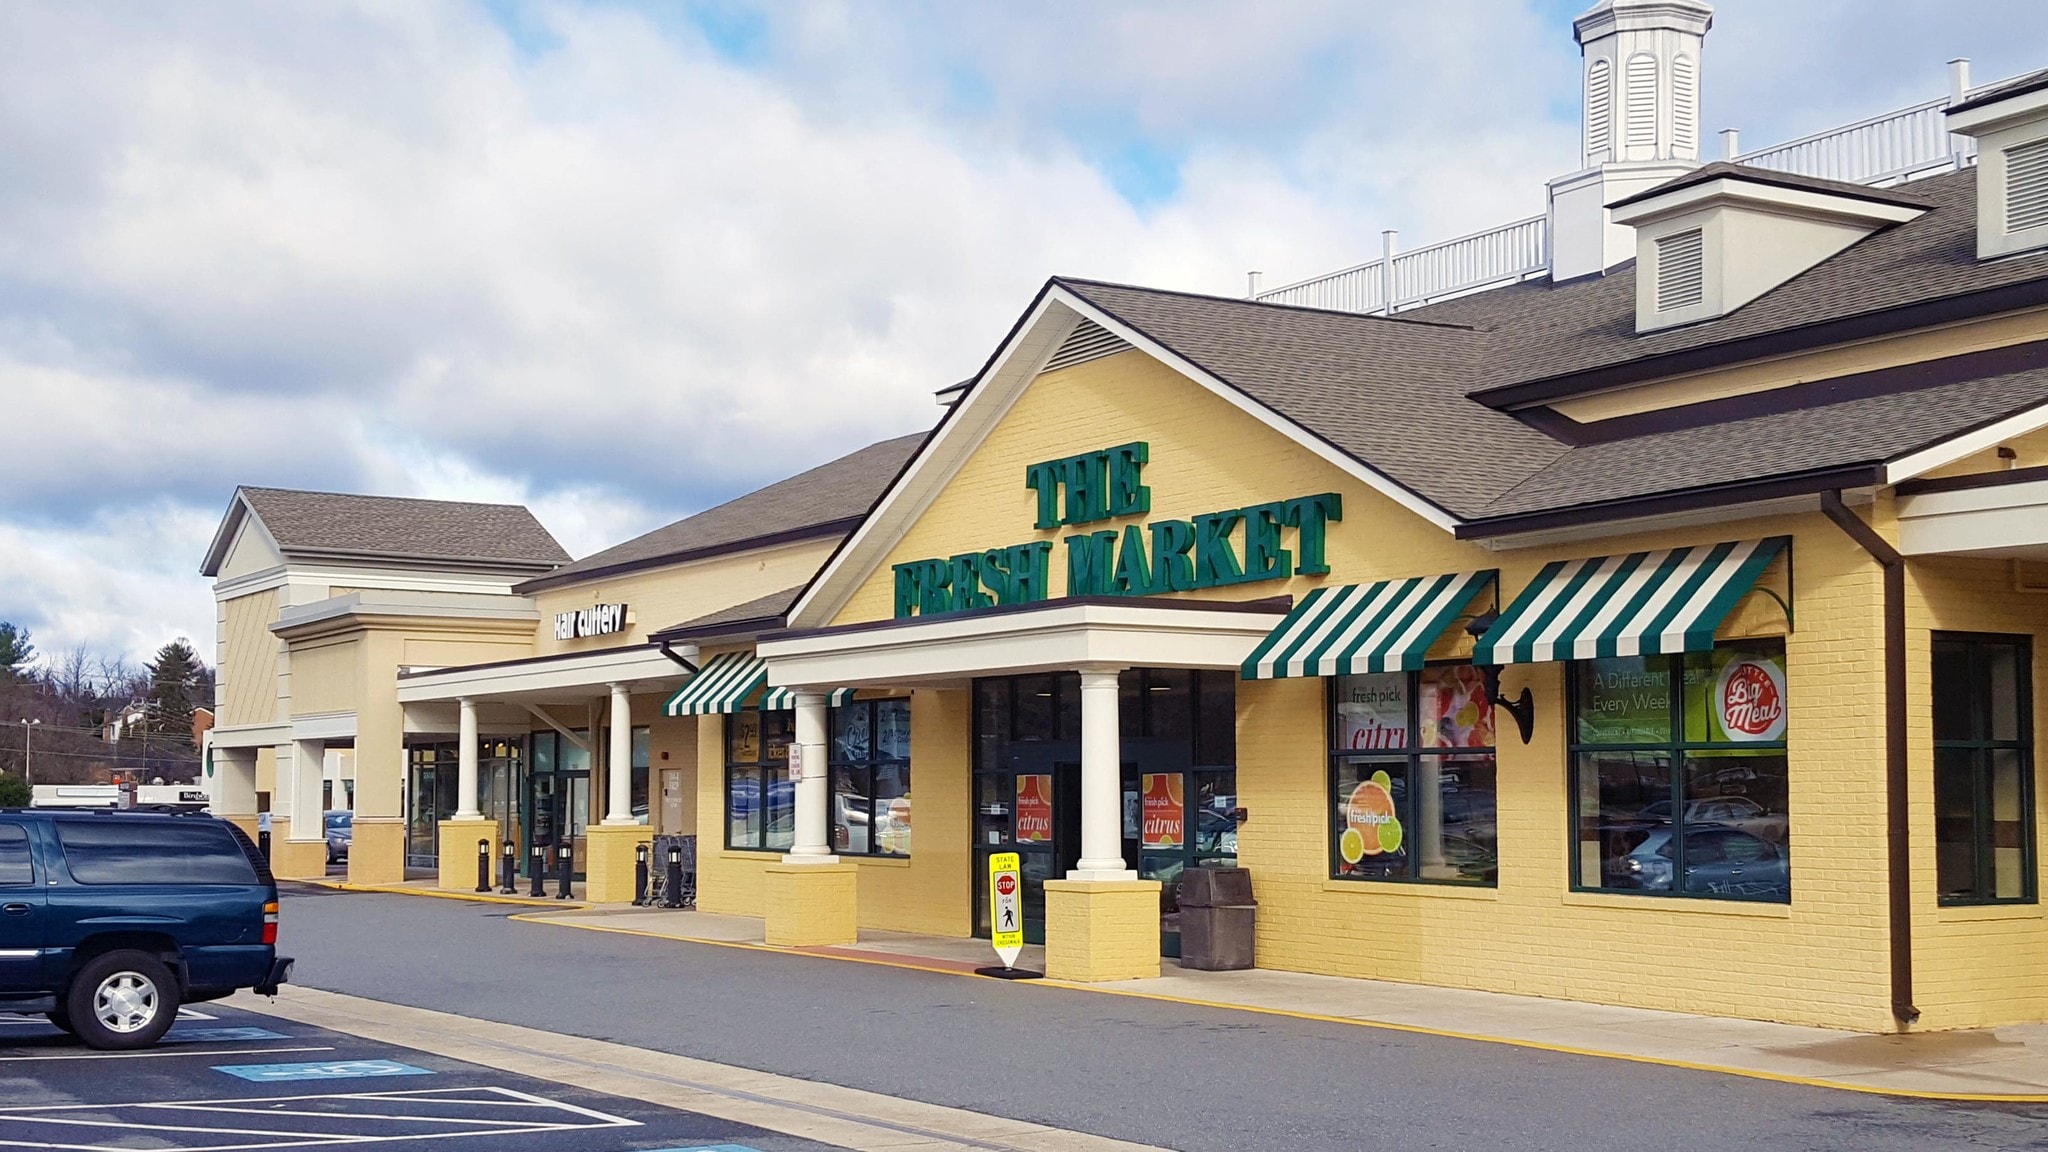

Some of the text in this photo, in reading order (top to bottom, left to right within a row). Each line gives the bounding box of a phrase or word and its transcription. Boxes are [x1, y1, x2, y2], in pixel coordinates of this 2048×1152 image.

[1026, 441, 1151, 530] THE
[892, 492, 1342, 618] FRESH MARKET
[554, 612, 576, 641] Hair
[1593, 673, 1605, 689] A
[1608, 671, 1666, 689] Different
[1352, 685, 1401, 706] fresh pick
[1728, 678, 1762, 706] Big
[1593, 695, 1629, 716] Every
[1726, 697, 1780, 730] Meal
[1018, 812, 1049, 831] citrus
[1144, 814, 1181, 834] citrus
[1350, 809, 1391, 827] fresh pick
[997, 881, 1015, 890] STOP
